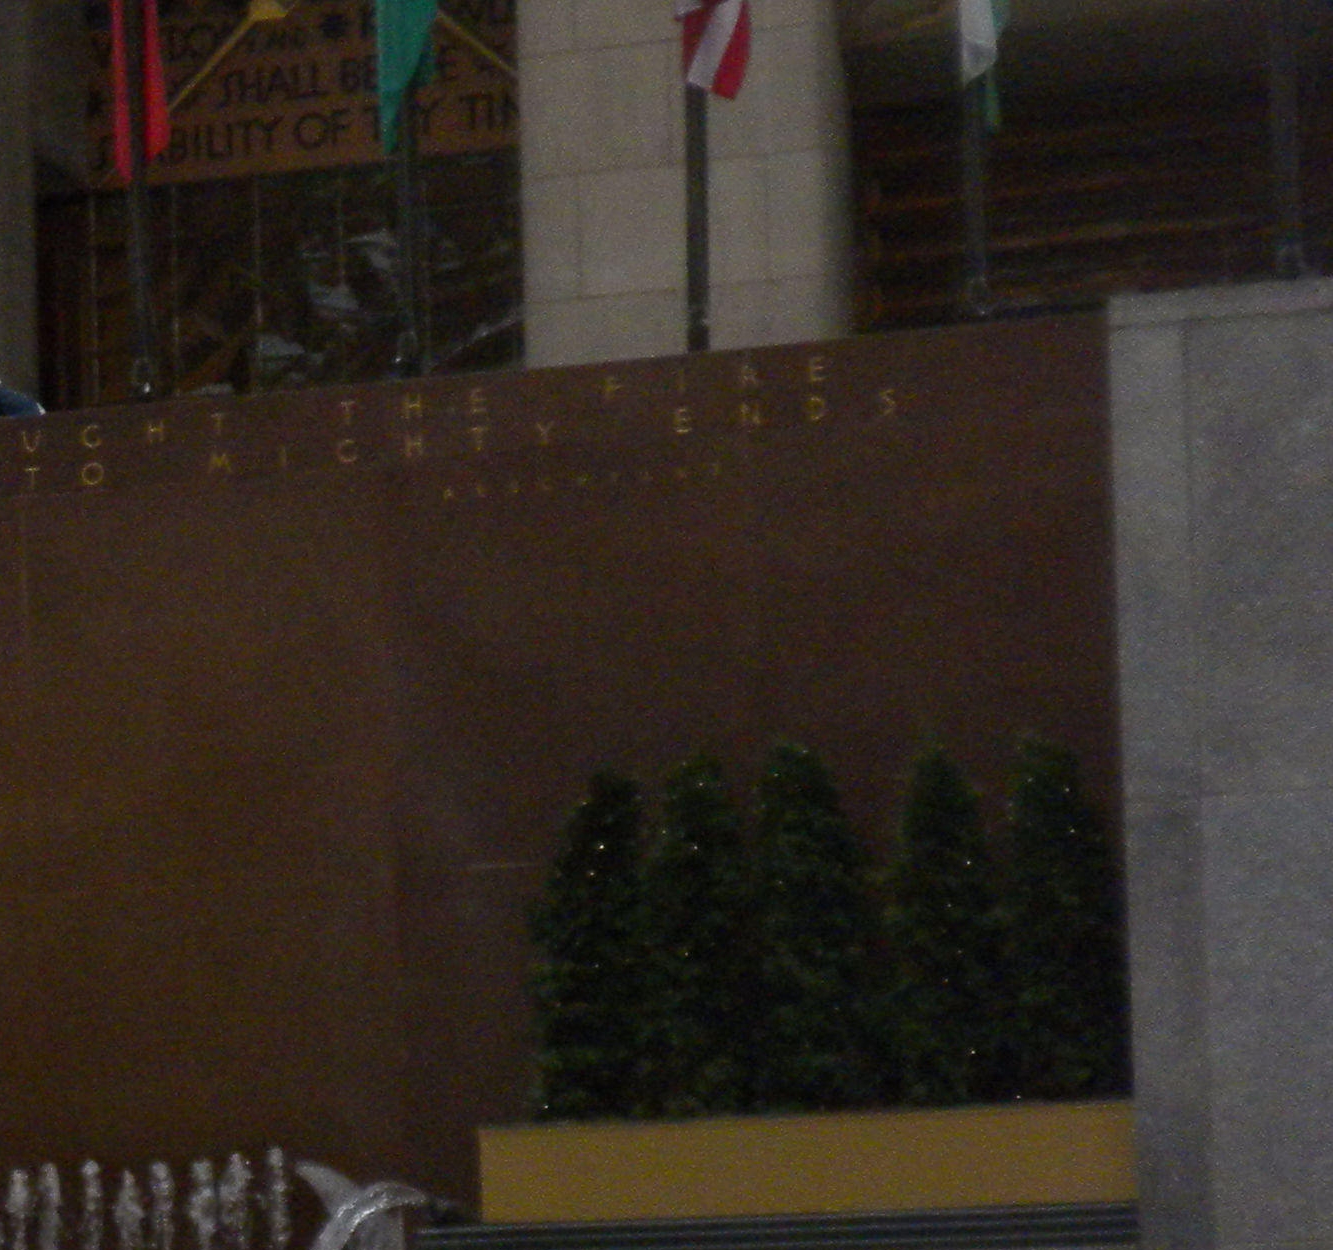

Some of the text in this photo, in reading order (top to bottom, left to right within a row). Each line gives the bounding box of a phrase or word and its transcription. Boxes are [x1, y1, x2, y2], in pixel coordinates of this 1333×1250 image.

[91, 117, 283, 171] SBILITY
[294, 108, 349, 149] OF
[340, 387, 488, 425] THE
[600, 355, 827, 401] FIRE
[23, 460, 106, 490] TO
[675, 387, 898, 435] ENDS
